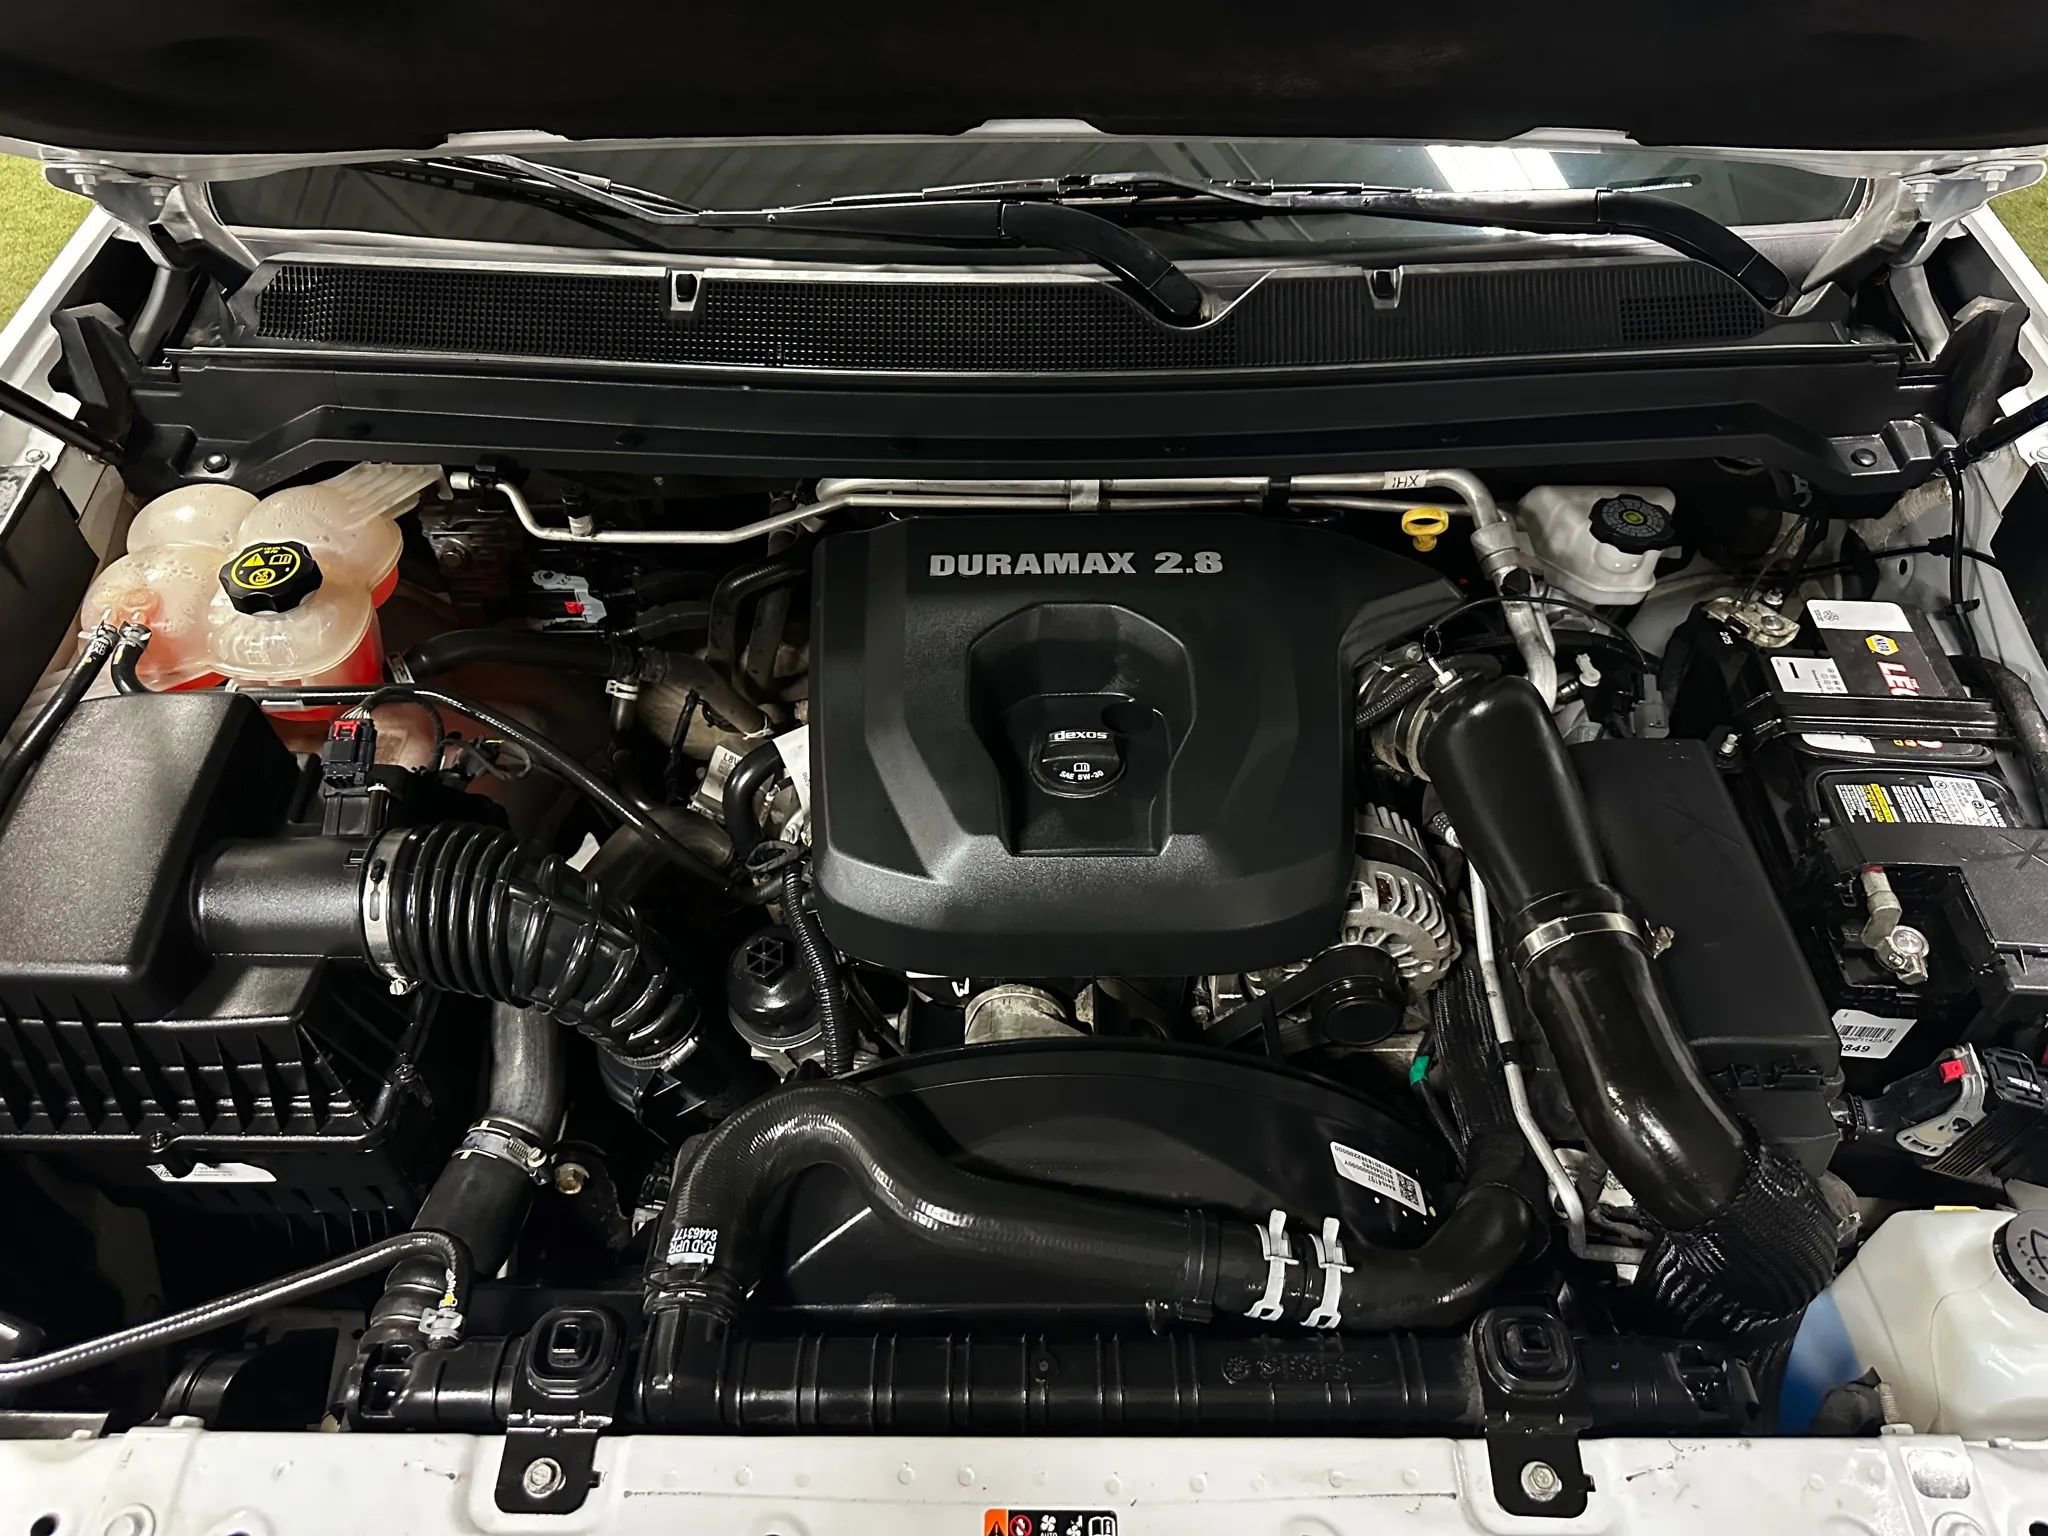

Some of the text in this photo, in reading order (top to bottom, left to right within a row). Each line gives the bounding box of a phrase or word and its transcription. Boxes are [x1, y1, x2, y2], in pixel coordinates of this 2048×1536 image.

[929, 551, 1223, 577] DURAMAX 2.8
[1054, 730, 1108, 740] dexos
[1059, 770, 1105, 781] SAE 5W-30
[671, 1227, 719, 1242] 84463177
[668, 1239, 717, 1255] RAD UPR
